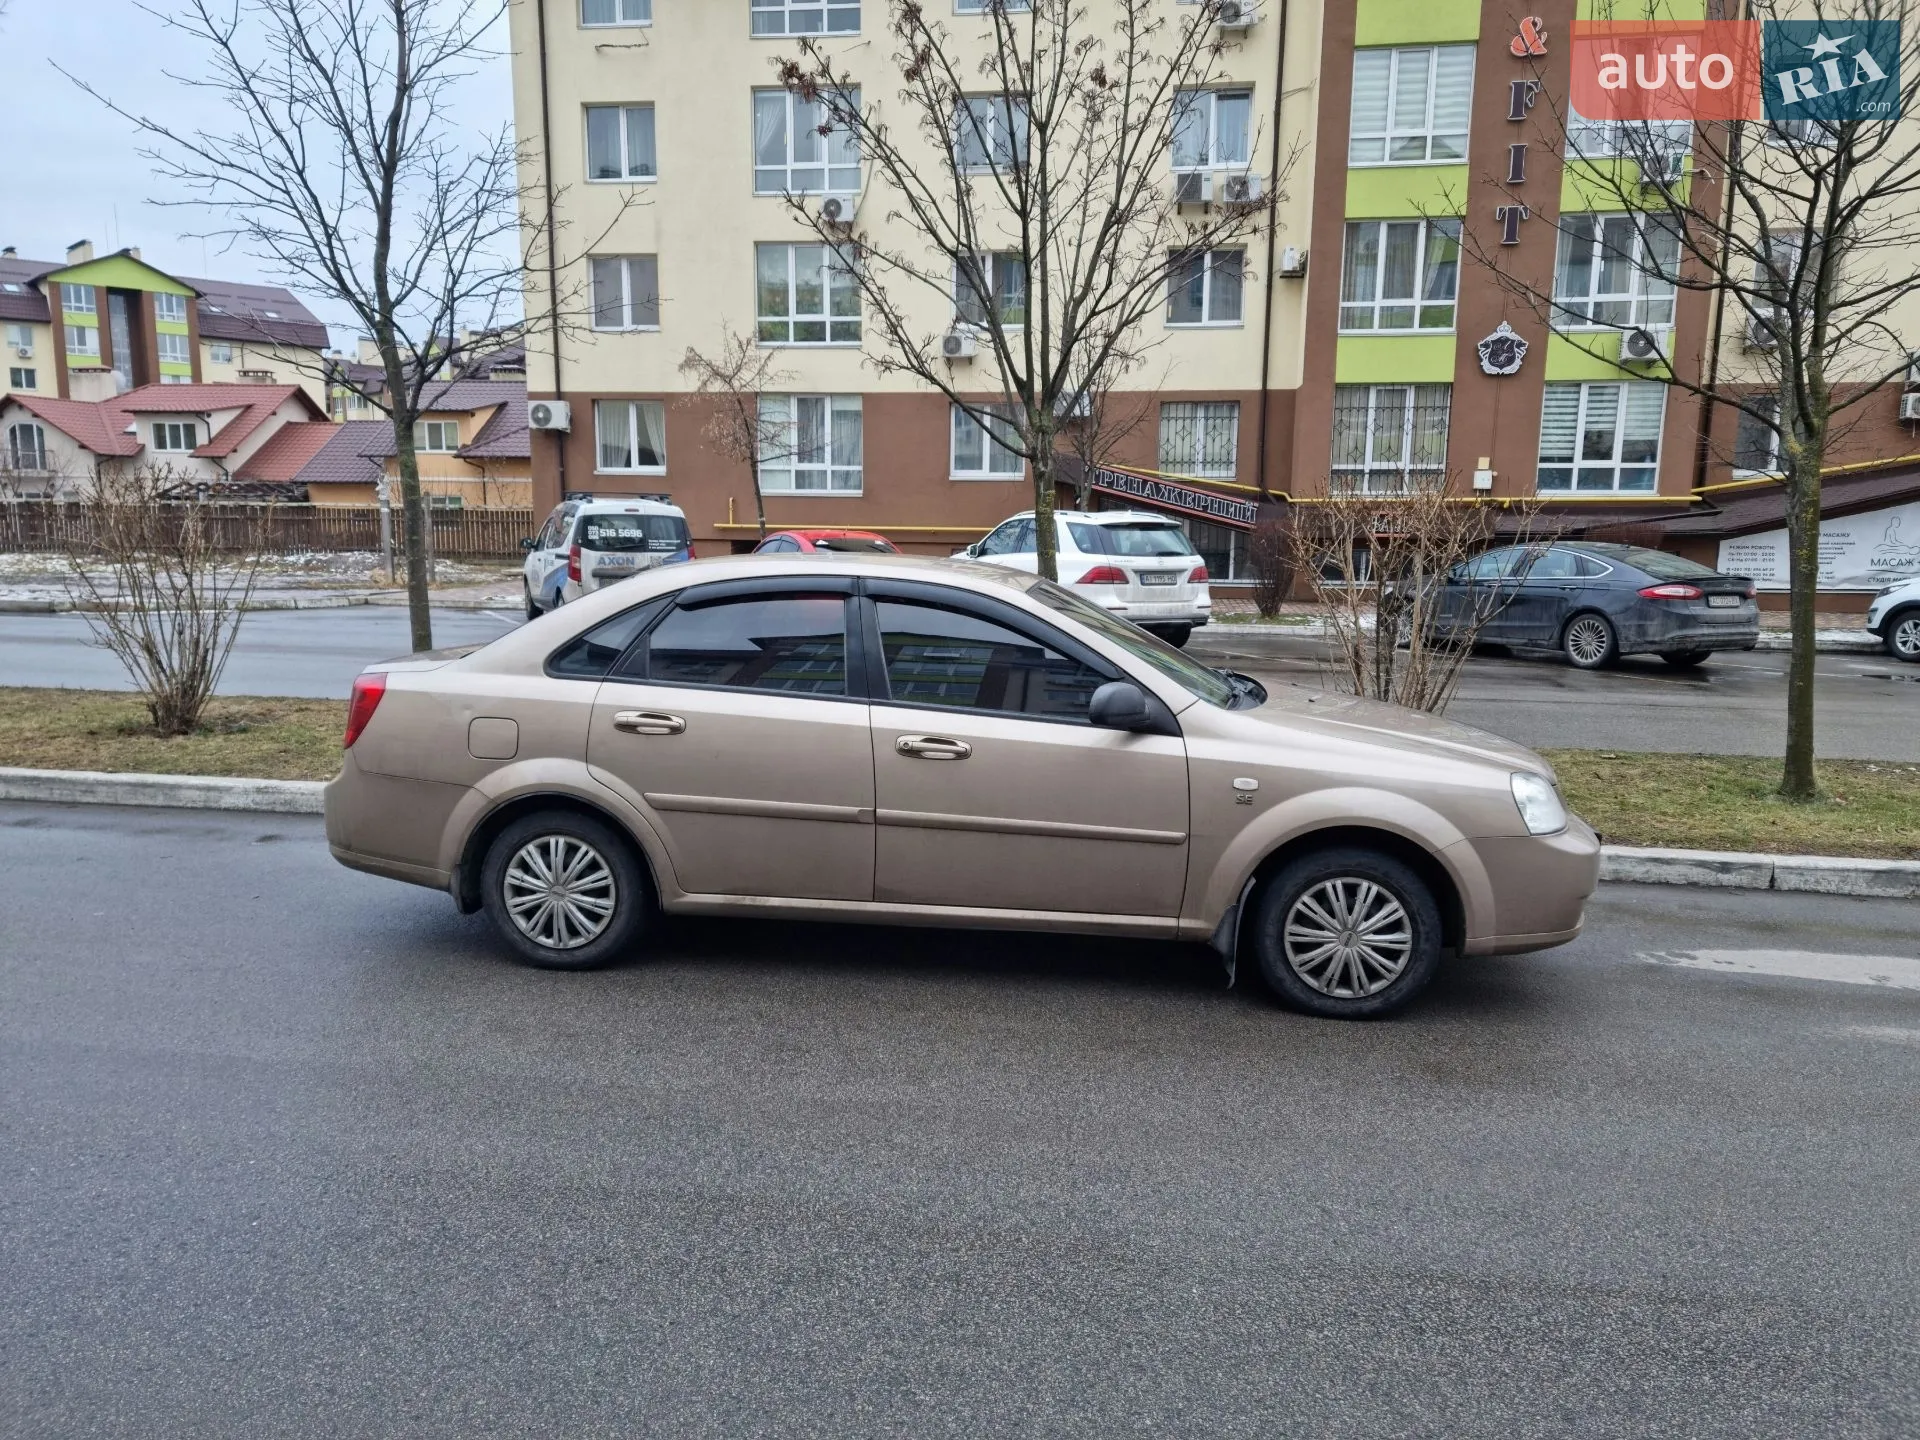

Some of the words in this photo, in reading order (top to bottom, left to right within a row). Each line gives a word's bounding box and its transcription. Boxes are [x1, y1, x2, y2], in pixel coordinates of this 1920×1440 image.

[1510, 16, 1547, 57] &
[600, 528, 617, 537] 516
[618, 528, 643, 538] 5696
[597, 556, 635, 566] AXON
[1870, 557, 1915, 567] МАСАЖ
[1235, 794, 1254, 805] SE
